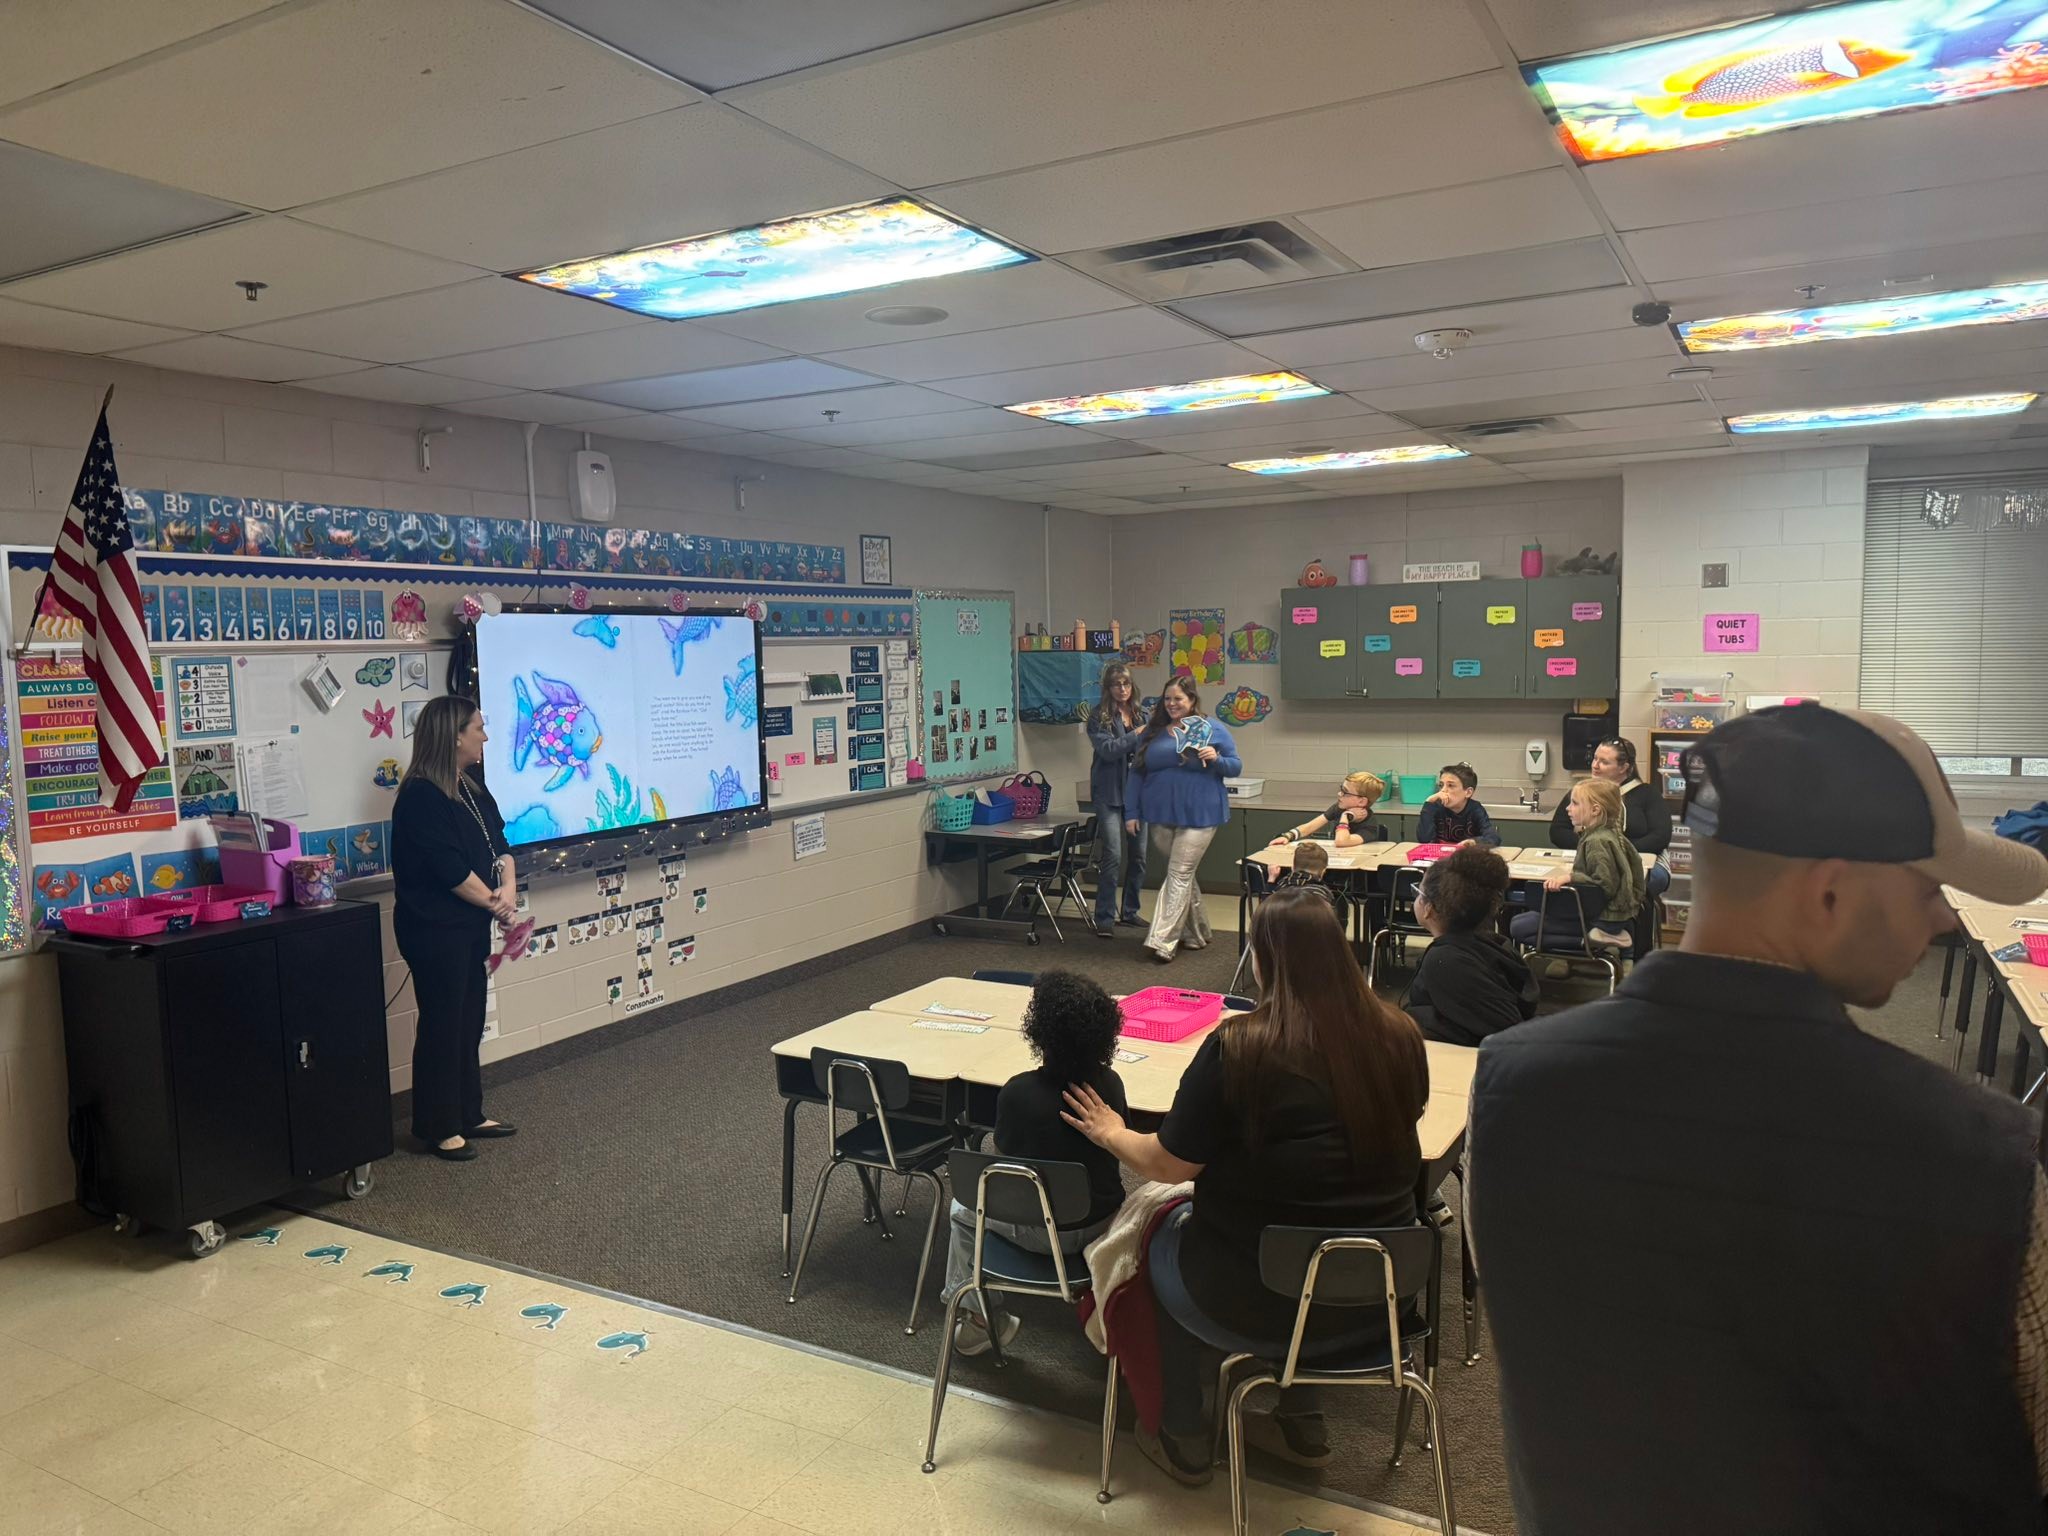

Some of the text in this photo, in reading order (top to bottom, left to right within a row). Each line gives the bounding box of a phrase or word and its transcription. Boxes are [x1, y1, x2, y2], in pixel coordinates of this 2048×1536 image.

[163, 493, 190, 514] Bb
[209, 498, 233, 517] Cc
[252, 501, 275, 520] Dd
[294, 505, 316, 522] Ee
[332, 508, 351, 525] Ff
[367, 511, 389, 532] Gg
[401, 513, 422, 530] Hh
[497, 520, 515, 536] Kk
[551, 524, 574, 540] Mm
[580, 527, 600, 542] Nn
[654, 534, 669, 551] Qq
[699, 538, 712, 551] Ss
[721, 540, 731, 553] Tt
[740, 541, 753, 554] Uu
[760, 543, 772, 554] Vv
[776, 543, 791, 555] Ww
[797, 545, 808, 558] Xx
[814, 547, 825, 560] Yy
[831, 549, 841, 560] Zz
[1424, 572, 1446, 580] HAPPY
[1171, 610, 1215, 619] Happy Birthday
[145, 619, 153, 641] 1
[171, 618, 186, 641] 2
[199, 618, 213, 641] 3
[226, 618, 240, 640] 4
[253, 618, 266, 640] 5
[278, 619, 290, 640] 6
[300, 618, 312, 640] 7
[324, 619, 336, 640] 8
[346, 618, 358, 639] 9
[366, 620, 384, 638] 10
[1716, 619, 1747, 629] QUIET
[1022, 636, 1070, 644] TEACH
[1718, 634, 1745, 644] TUBS
[192, 666, 199, 676] 4
[27, 682, 95, 693] ALWAYS DO
[193, 679, 199, 690] 3
[47, 698, 84, 709] Listen
[194, 693, 200, 703] 2
[195, 707, 200, 717] 1
[40, 714, 83, 727] FOLLOW
[196, 720, 202, 730] 0
[31, 731, 61, 743] Raise
[64, 730, 88, 742] your
[38, 745, 97, 759] TREAT OTHERS
[178, 746, 232, 765] M AND W
[40, 764, 72, 775] Make
[56, 795, 76, 806] TRY
[45, 812, 72, 822] Learn
[74, 809, 95, 820] from
[129, 801, 161, 813] stakes
[69, 819, 140, 836] BE YOURSELF
[356, 862, 379, 872] White
[46, 907, 62, 920] Re
[626, 994, 664, 1013] Consonants
